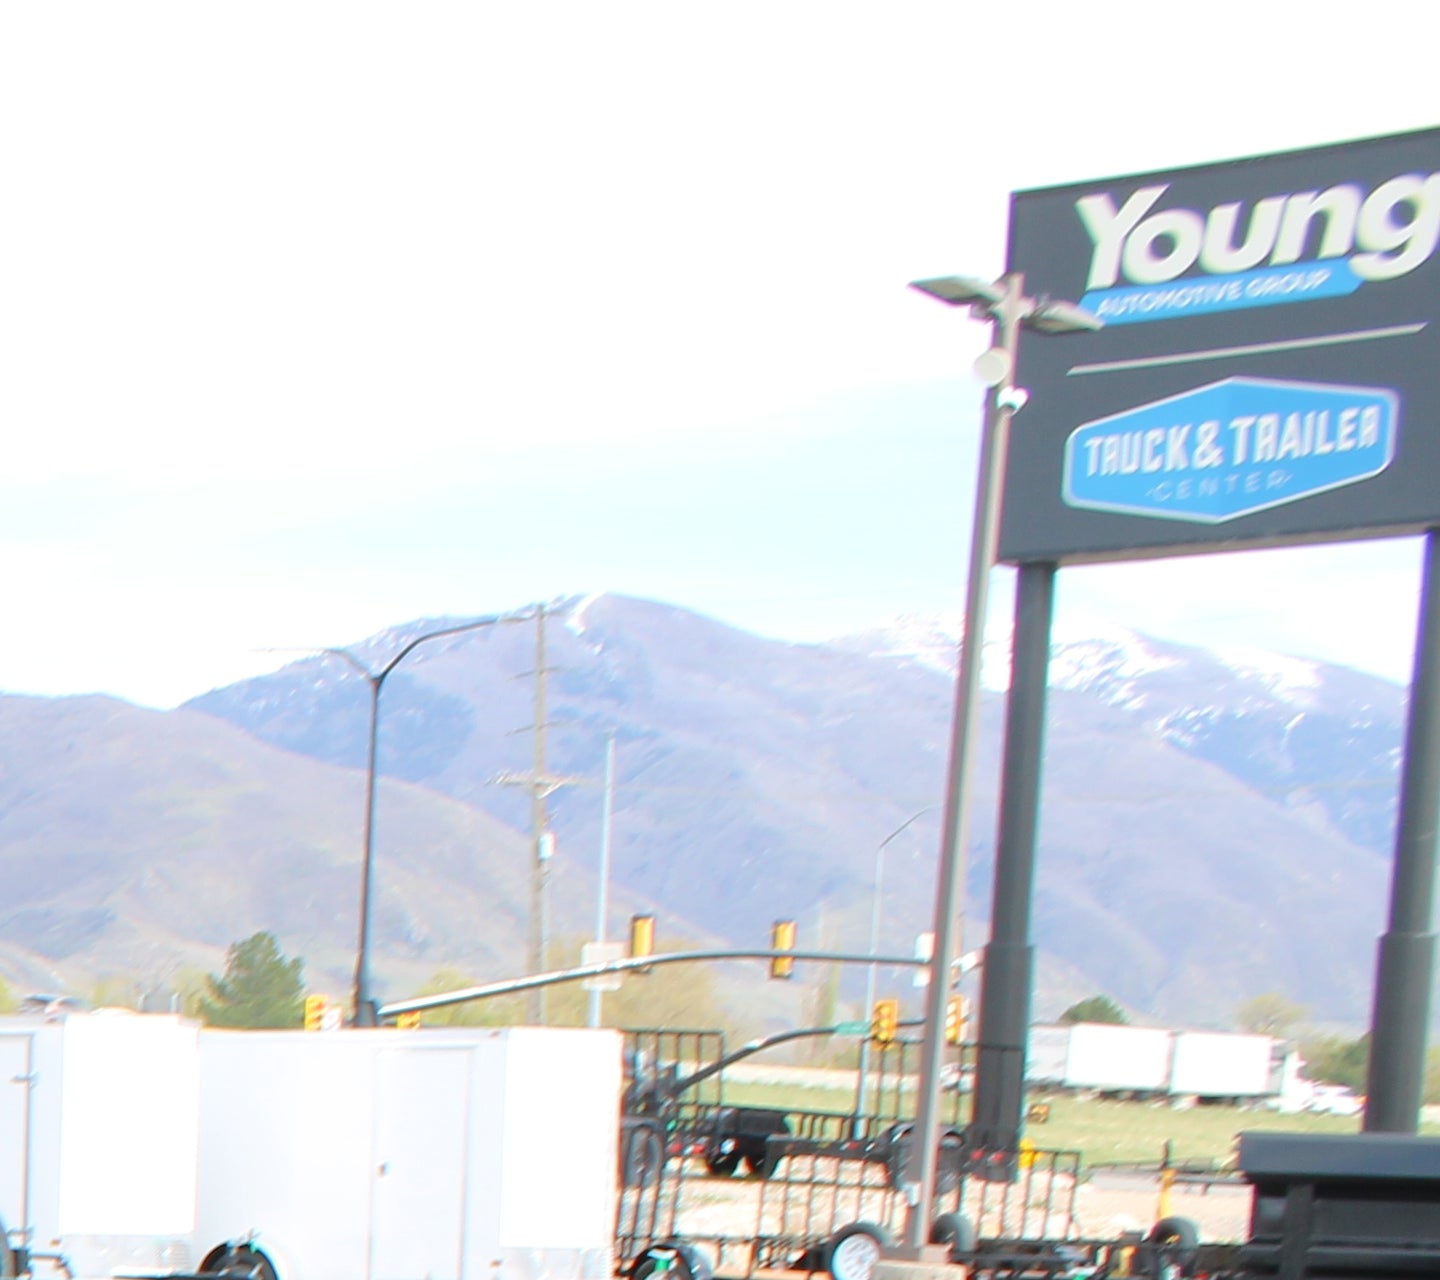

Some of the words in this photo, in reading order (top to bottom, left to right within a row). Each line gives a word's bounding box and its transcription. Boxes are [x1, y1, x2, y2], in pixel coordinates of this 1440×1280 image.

[1076, 173, 1440, 290] Young
[1095, 280, 1242, 318] AUTOMOTIVE
[1245, 269, 1332, 298] GROUP
[1085, 424, 1189, 477] TRUCK
[1193, 421, 1222, 471] &
[1229, 404, 1381, 465] TRAILER
[1154, 472, 1287, 503] CENTER
